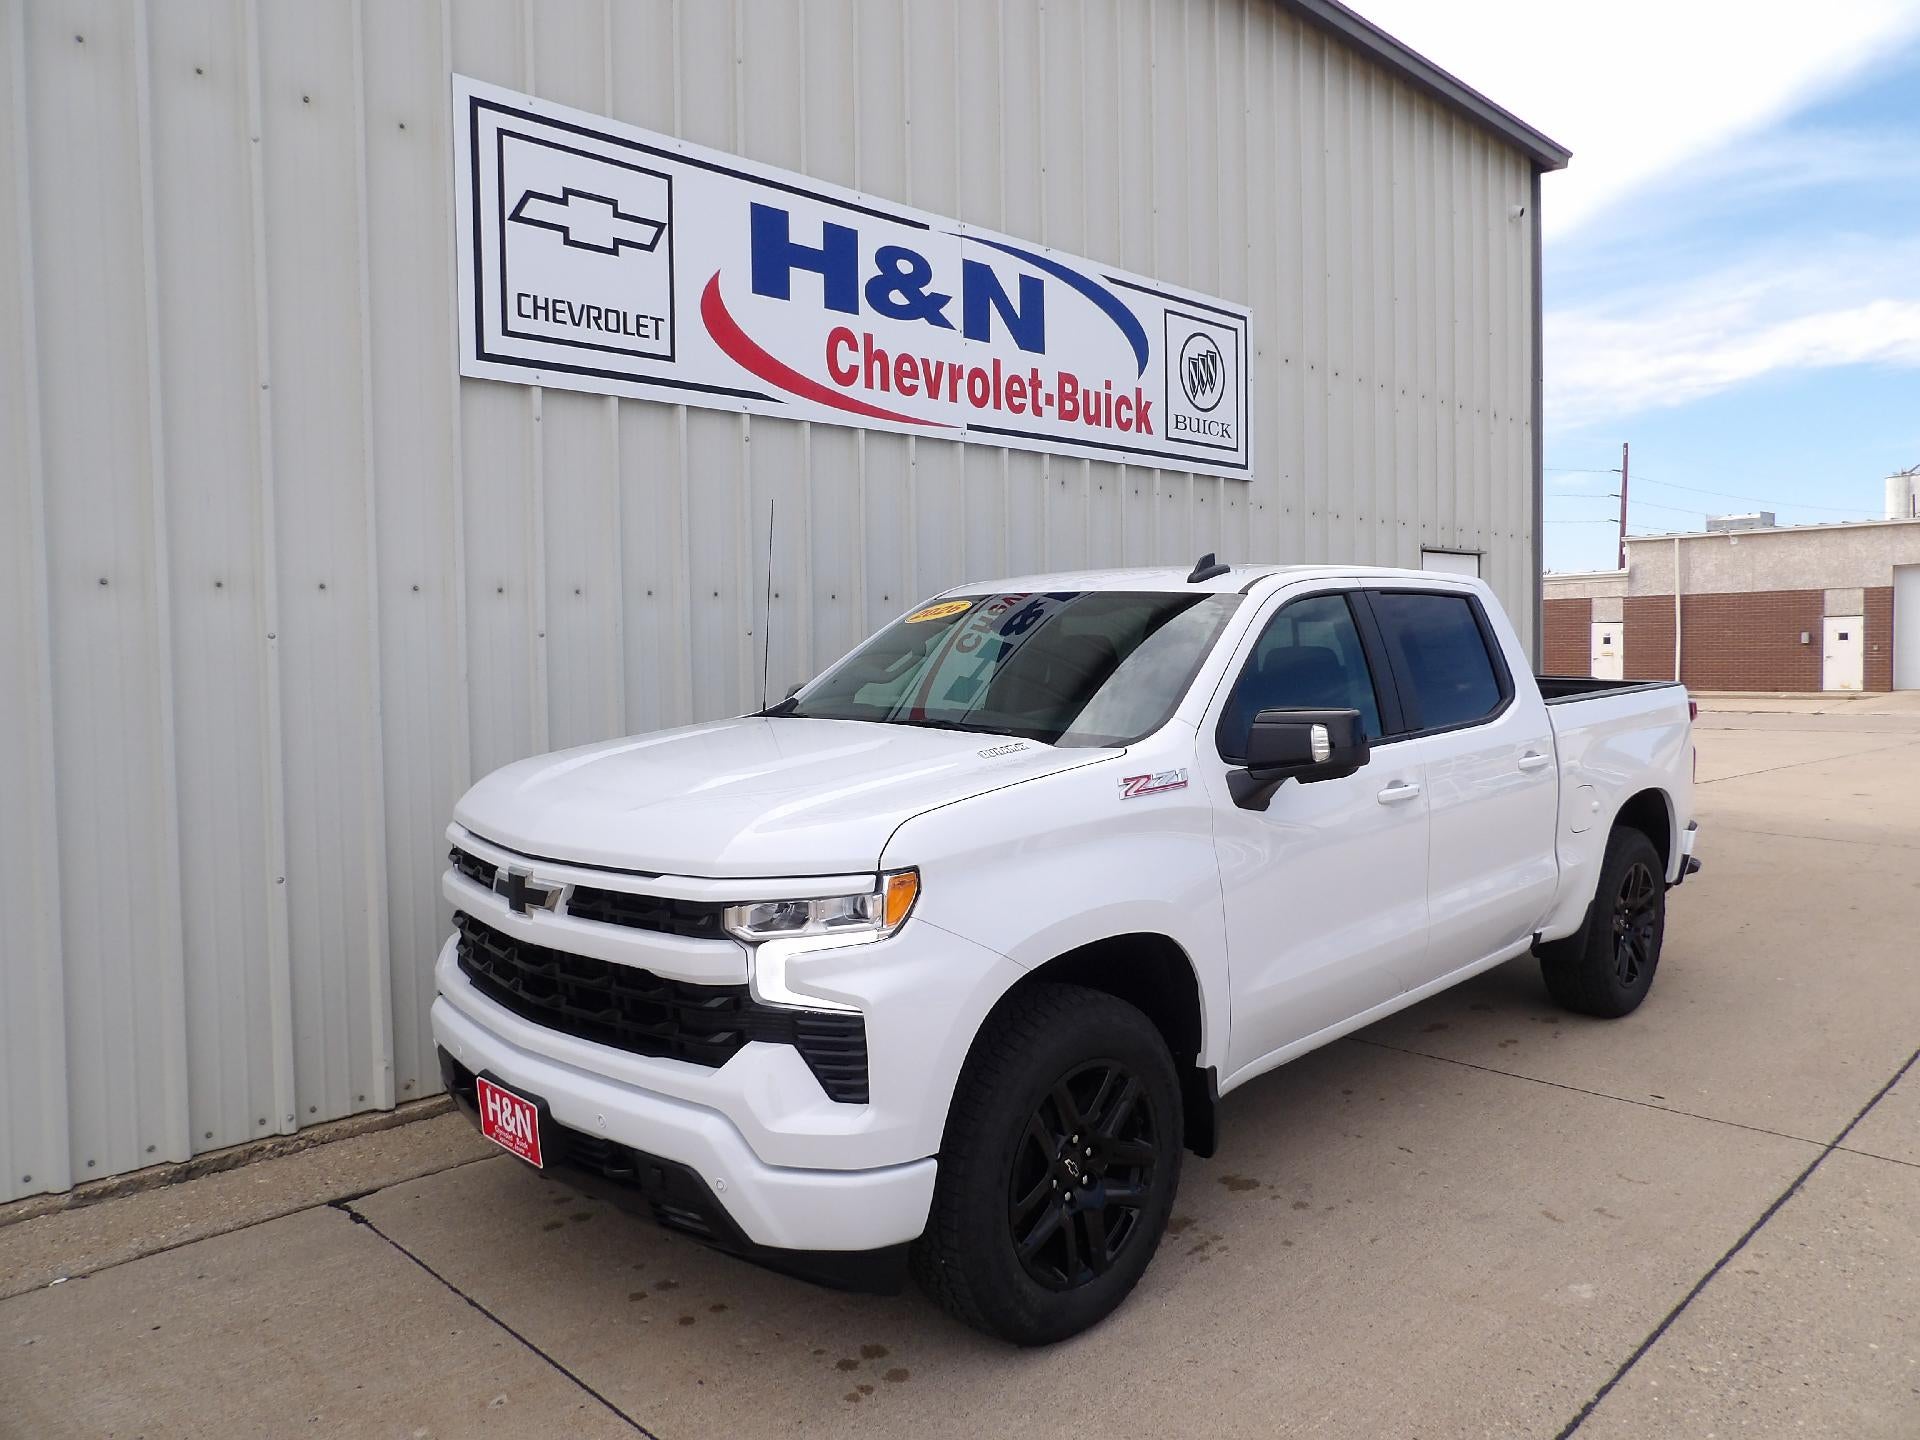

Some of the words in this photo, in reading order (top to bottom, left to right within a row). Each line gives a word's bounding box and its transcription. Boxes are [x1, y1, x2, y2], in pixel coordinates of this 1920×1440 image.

[750, 201, 1045, 355] H&N
[516, 291, 665, 341] CHEVROLET
[825, 326, 1153, 436] Chevrolet-Buick
[1173, 413, 1232, 439] BUICK
[1118, 768, 1188, 800] Z71
[486, 1088, 533, 1144] H&N
